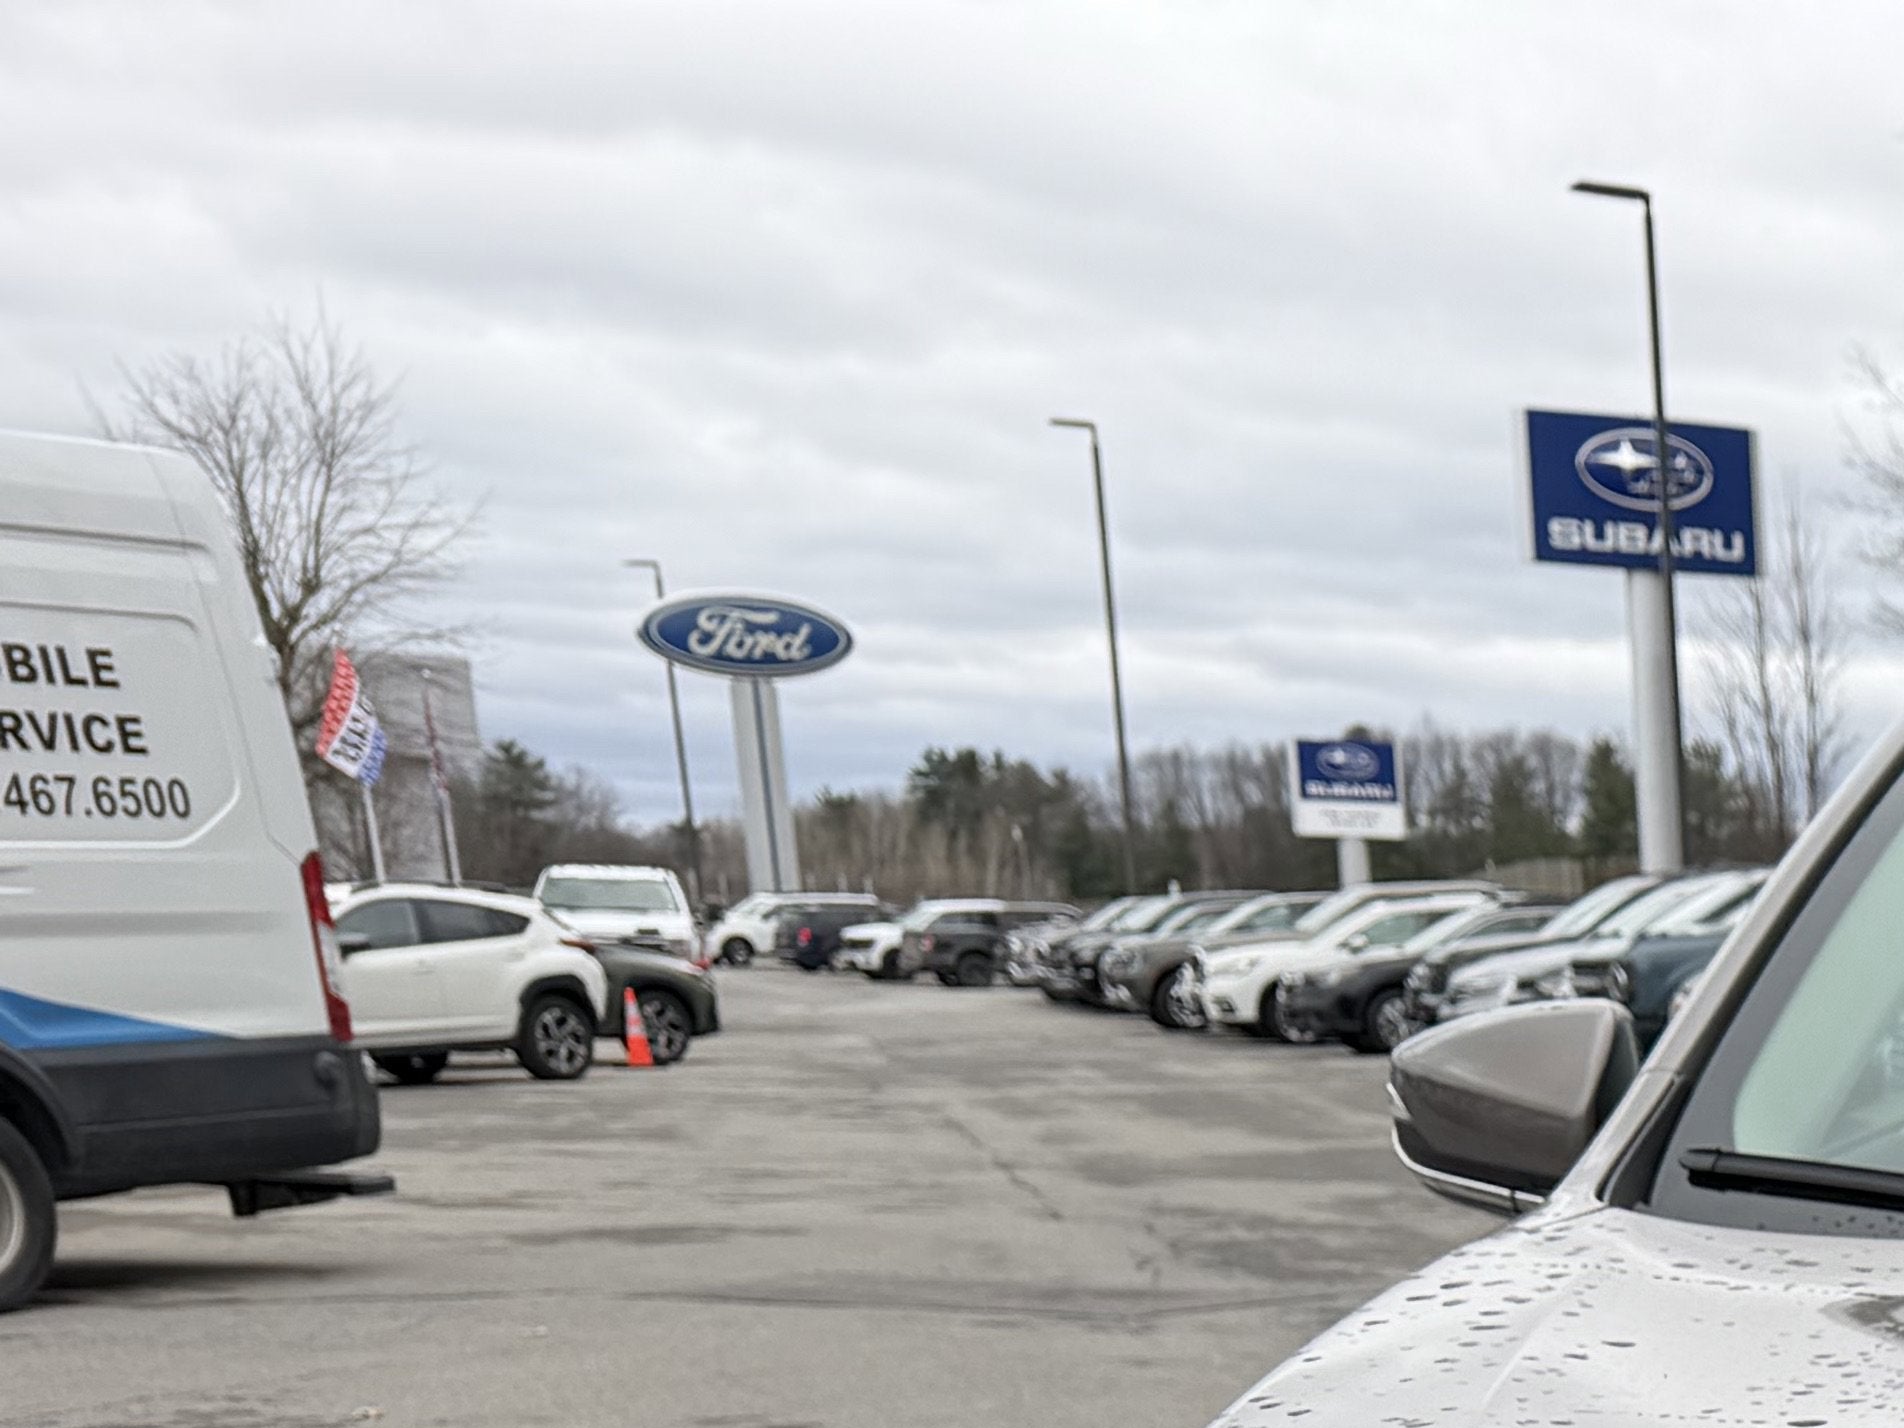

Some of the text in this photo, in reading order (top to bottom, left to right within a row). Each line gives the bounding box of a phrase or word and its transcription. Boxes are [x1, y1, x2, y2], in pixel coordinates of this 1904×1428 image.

[1547, 516, 1745, 563] SUBARU
[687, 604, 813, 660] Ford
[0, 643, 120, 688] BILE
[4, 772, 192, 818] 467.6500
